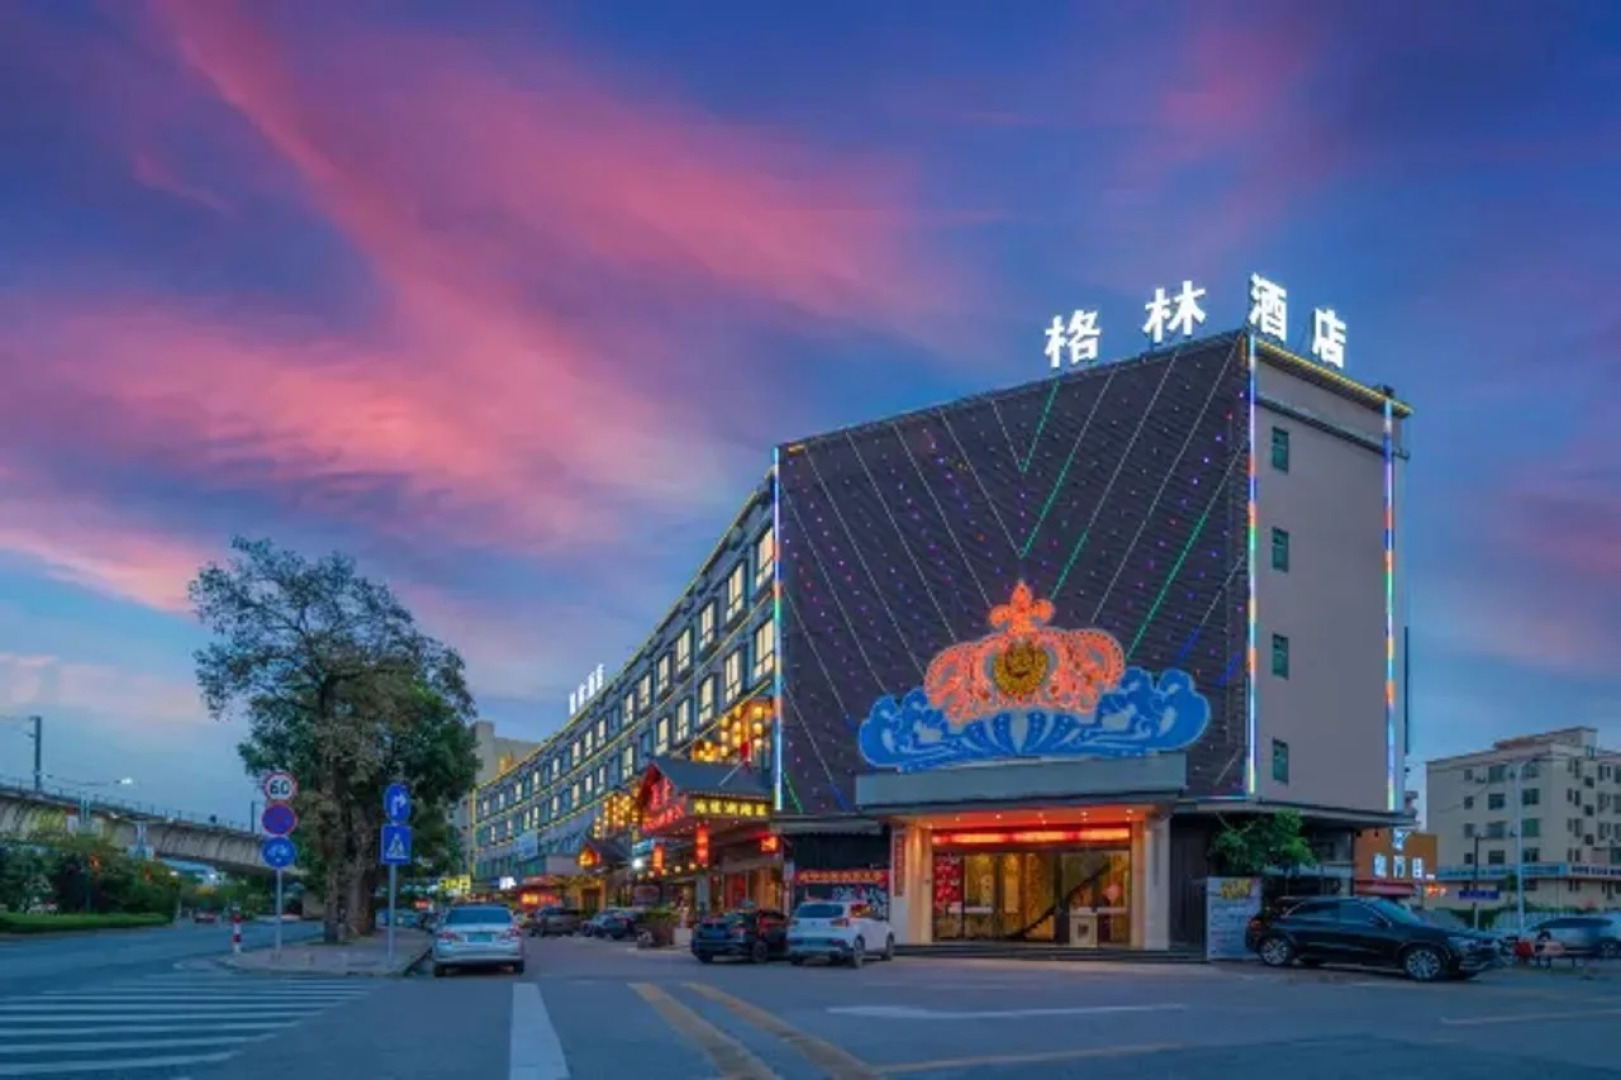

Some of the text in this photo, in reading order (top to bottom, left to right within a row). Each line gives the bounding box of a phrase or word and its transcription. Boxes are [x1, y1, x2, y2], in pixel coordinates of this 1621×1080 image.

[1044, 272, 1347, 369] 格林酒店
[270, 780, 291, 795] 60
